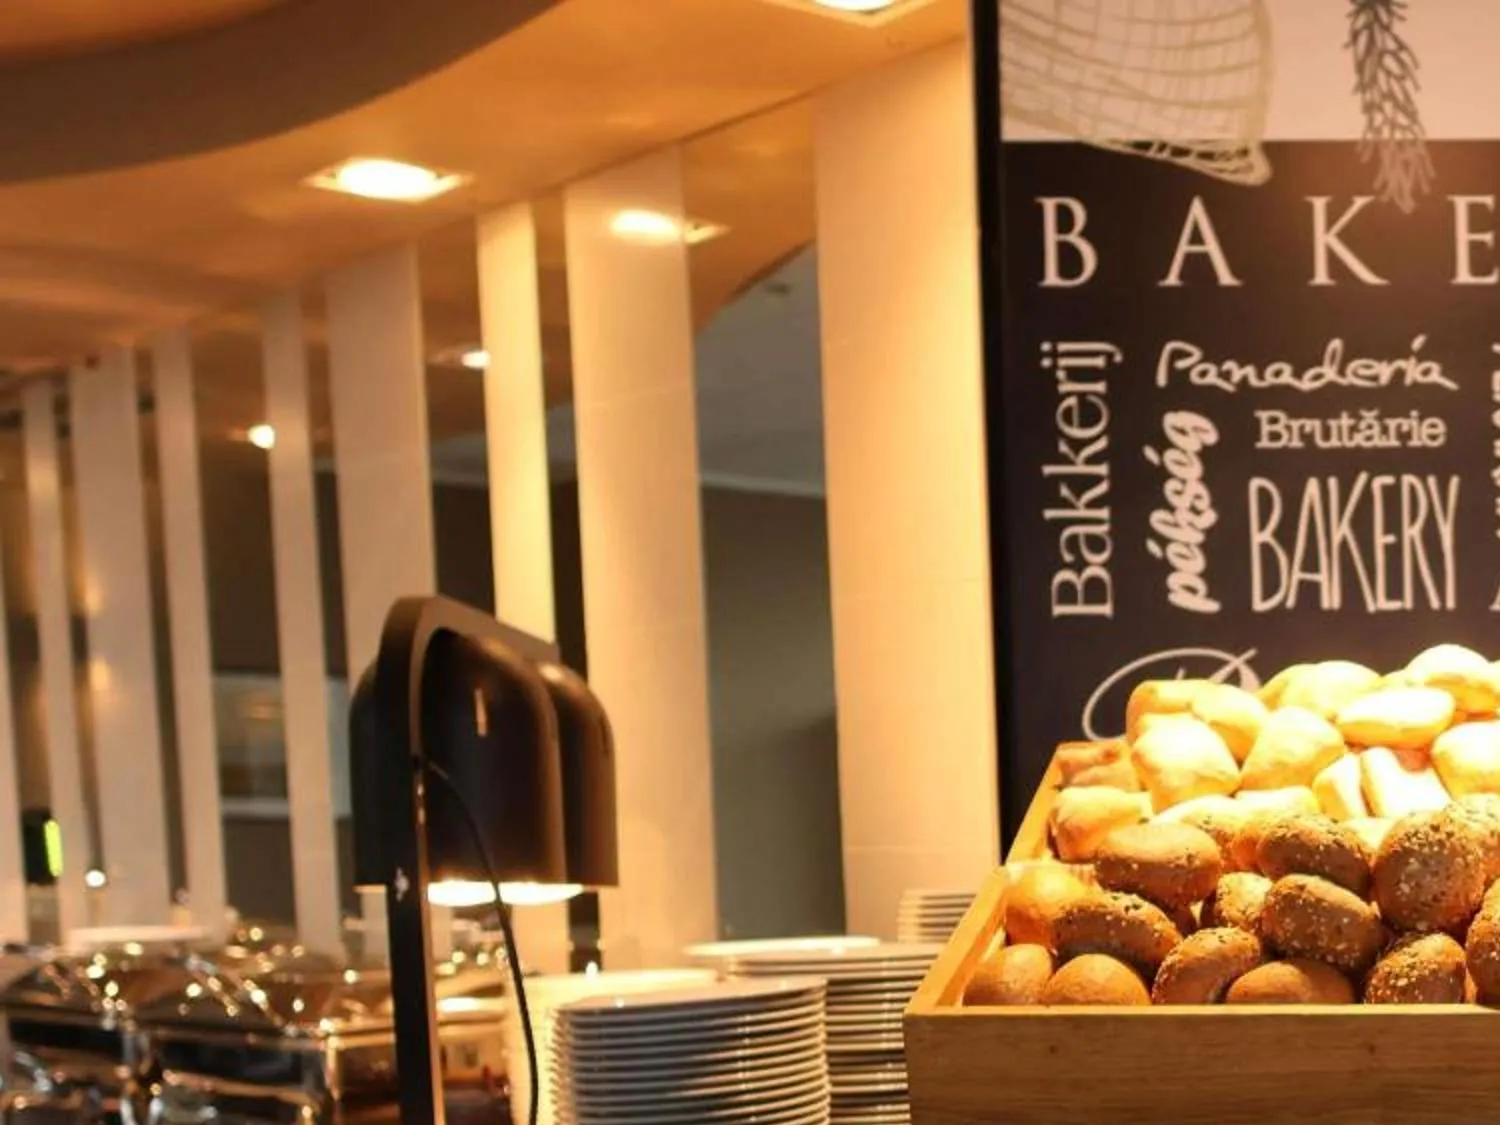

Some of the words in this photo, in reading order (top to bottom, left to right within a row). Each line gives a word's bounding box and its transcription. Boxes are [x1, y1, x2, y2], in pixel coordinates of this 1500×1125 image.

[1156, 334, 1460, 393] Panadería
[1253, 408, 1449, 449] Brutărie
[1040, 340, 1124, 618] Bakkerij
[1143, 410, 1222, 613] pékség
[1248, 471, 1461, 614] BAKERY
